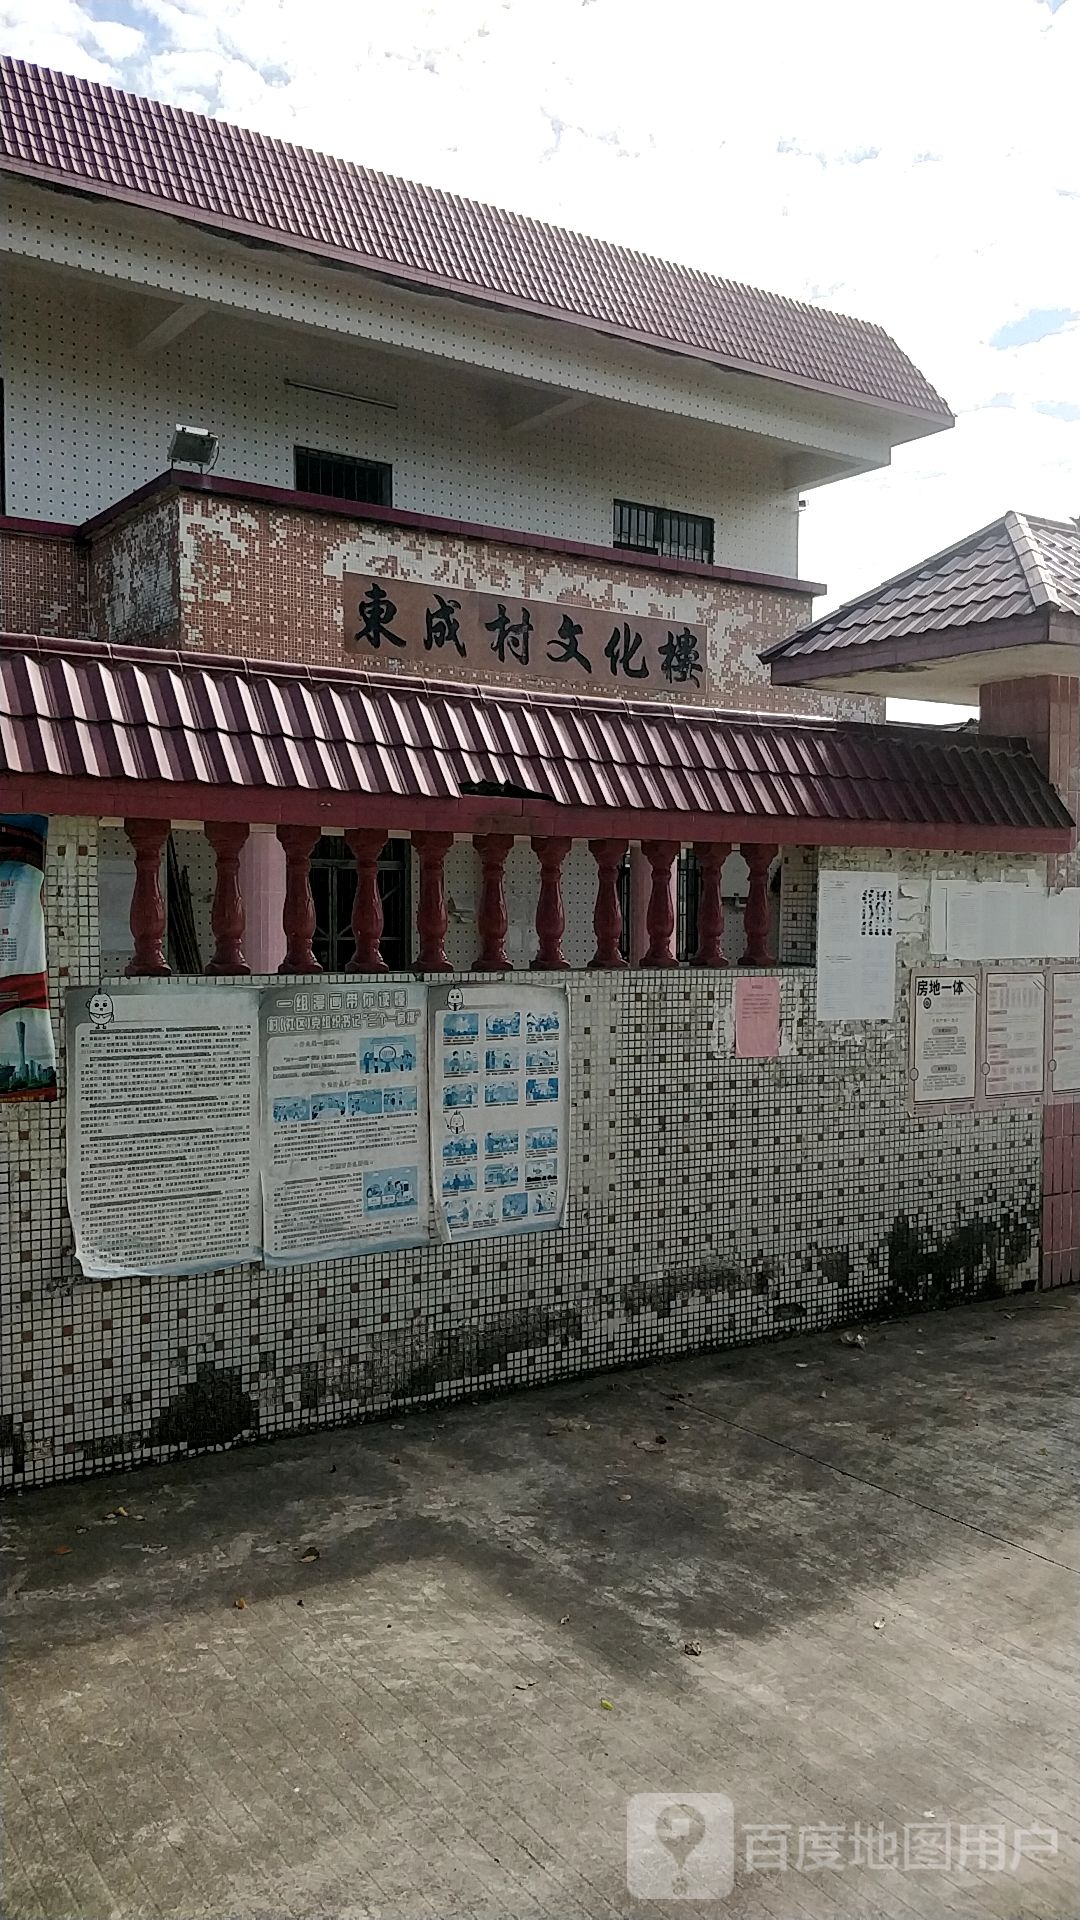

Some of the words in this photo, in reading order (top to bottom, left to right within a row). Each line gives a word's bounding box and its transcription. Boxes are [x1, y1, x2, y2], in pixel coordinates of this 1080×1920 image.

[354, 583, 704, 689] 東成村文化樓
[917, 980, 964, 996] 房地一体
